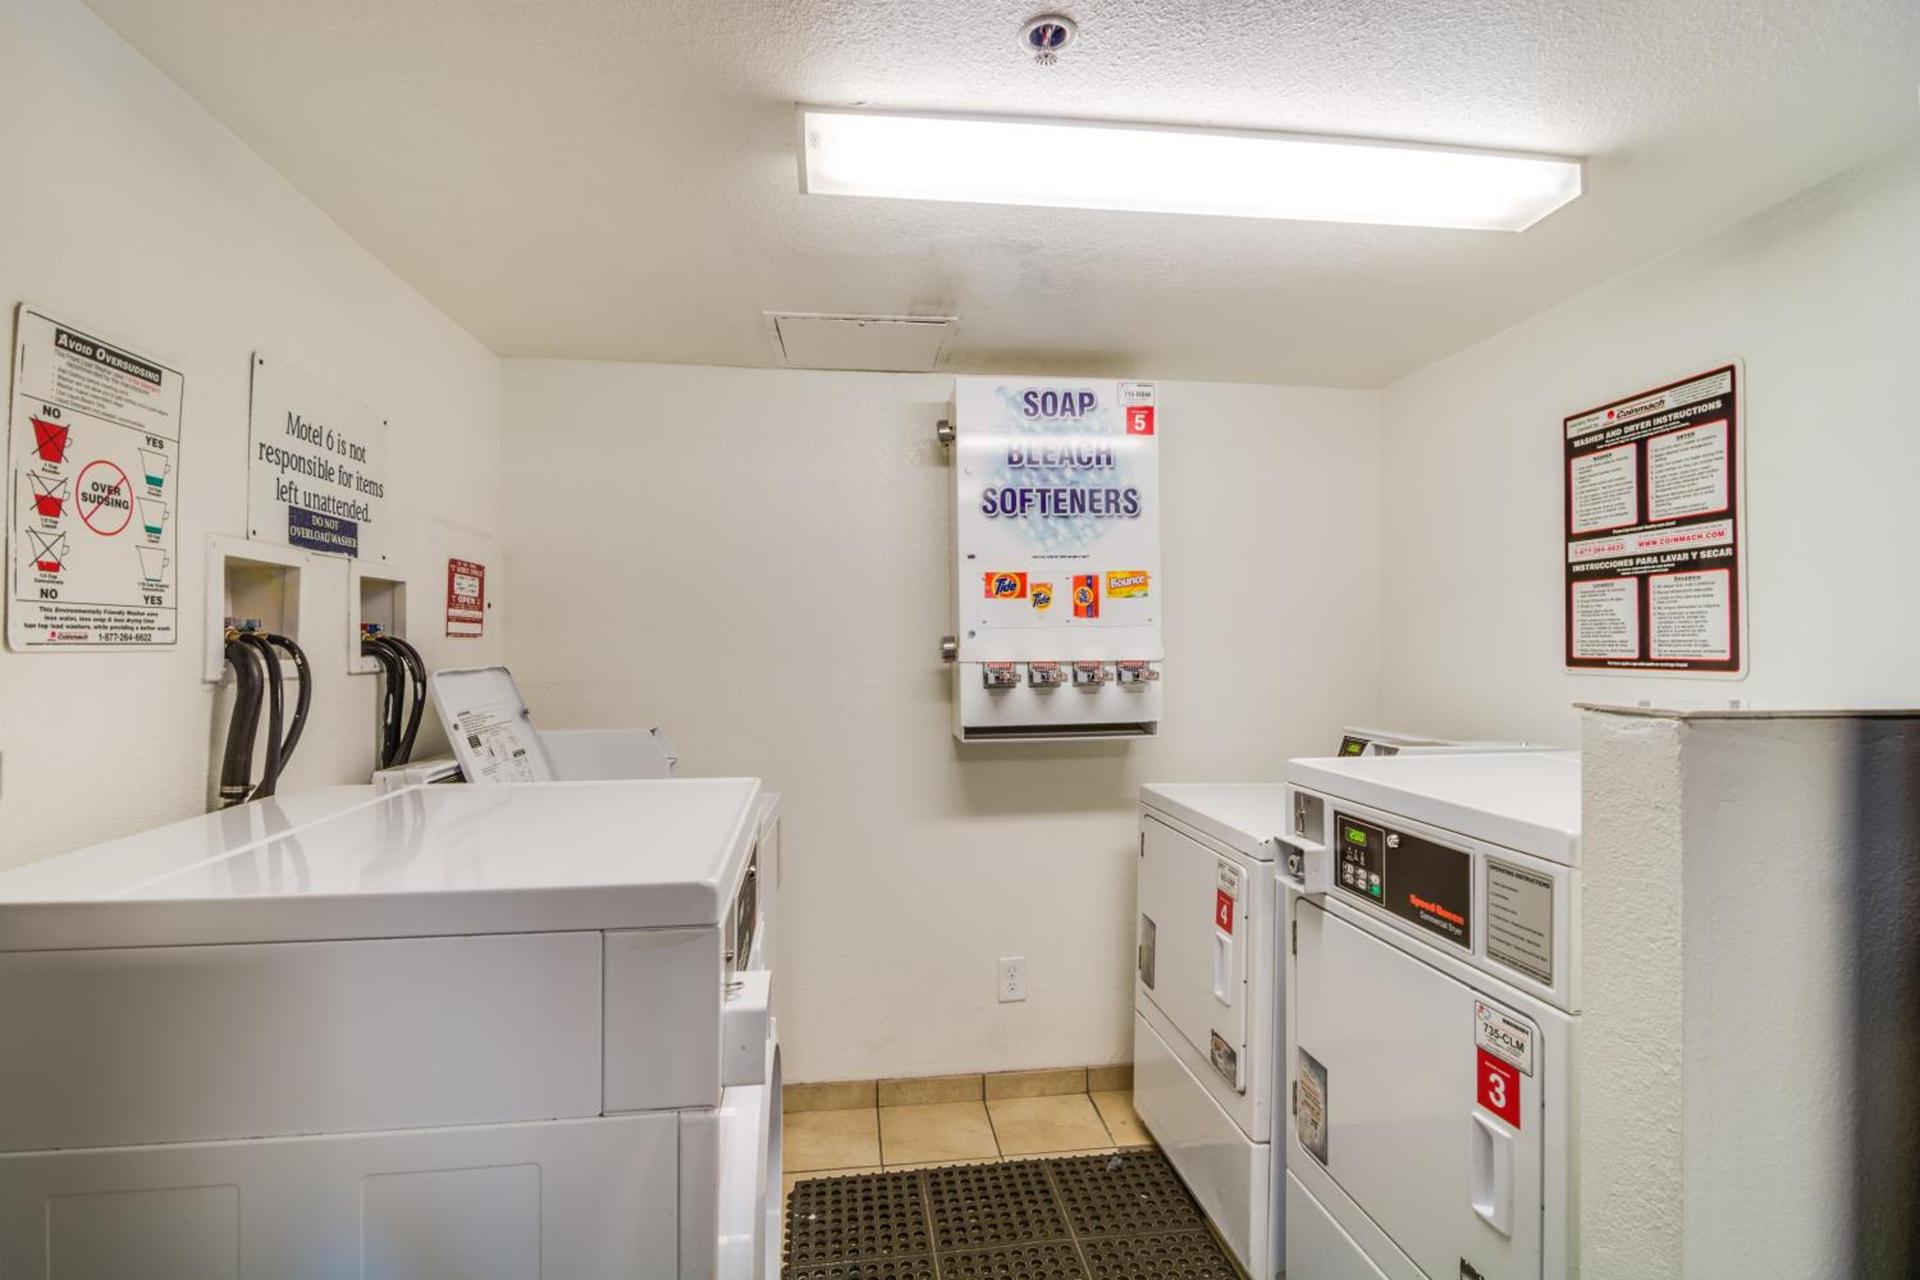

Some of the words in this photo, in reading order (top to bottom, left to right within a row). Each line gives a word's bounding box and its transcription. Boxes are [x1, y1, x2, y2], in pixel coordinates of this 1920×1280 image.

[42, 404, 61, 420] NO
[1023, 390, 1096, 417] SOAP
[1616, 399, 1665, 419] Coinmach
[1135, 414, 1146, 431] 5
[1573, 432, 1605, 448] WASHER
[1605, 427, 1622, 439] AND
[1623, 420, 1653, 435] DRYER
[1653, 400, 1723, 426] INSTRUCTIONS
[145, 435, 164, 450] YES
[286, 411, 323, 448] Motel
[326, 430, 334, 451] 6
[337, 433, 347, 456] is
[349, 443, 367, 464] not
[1007, 441, 1113, 466] BLEACH
[258, 441, 335, 483] responsible
[337, 464, 353, 489] for
[355, 470, 384, 498] items
[91, 481, 121, 497] OVER
[81, 492, 129, 510] SUDSING
[276, 477, 299, 505] left
[303, 490, 372, 523] unattended.
[981, 487, 1139, 515] SOFTENERS
[311, 514, 324, 527] DO
[324, 518, 339, 530] NOT
[290, 525, 330, 543] OVERLOAD
[1638, 530, 1725, 548] WWW.COINMACH.COM
[1572, 557, 1634, 573] INSTRUCCIONES
[1635, 555, 1658, 566] PARA
[1660, 551, 1689, 563] LAVAR
[1691, 551, 1699, 560] Y
[1700, 547, 1733, 559] SECAR
[995, 576, 1017, 595] Tide
[1110, 575, 1145, 589] Bounce
[40, 588, 58, 600] NO
[143, 595, 163, 606] YES
[1032, 592, 1050, 608] Tide
[1220, 904, 1228, 926] 4
[1483, 1022, 1525, 1053] 735-CLM
[1487, 1073, 1507, 1108] 3
